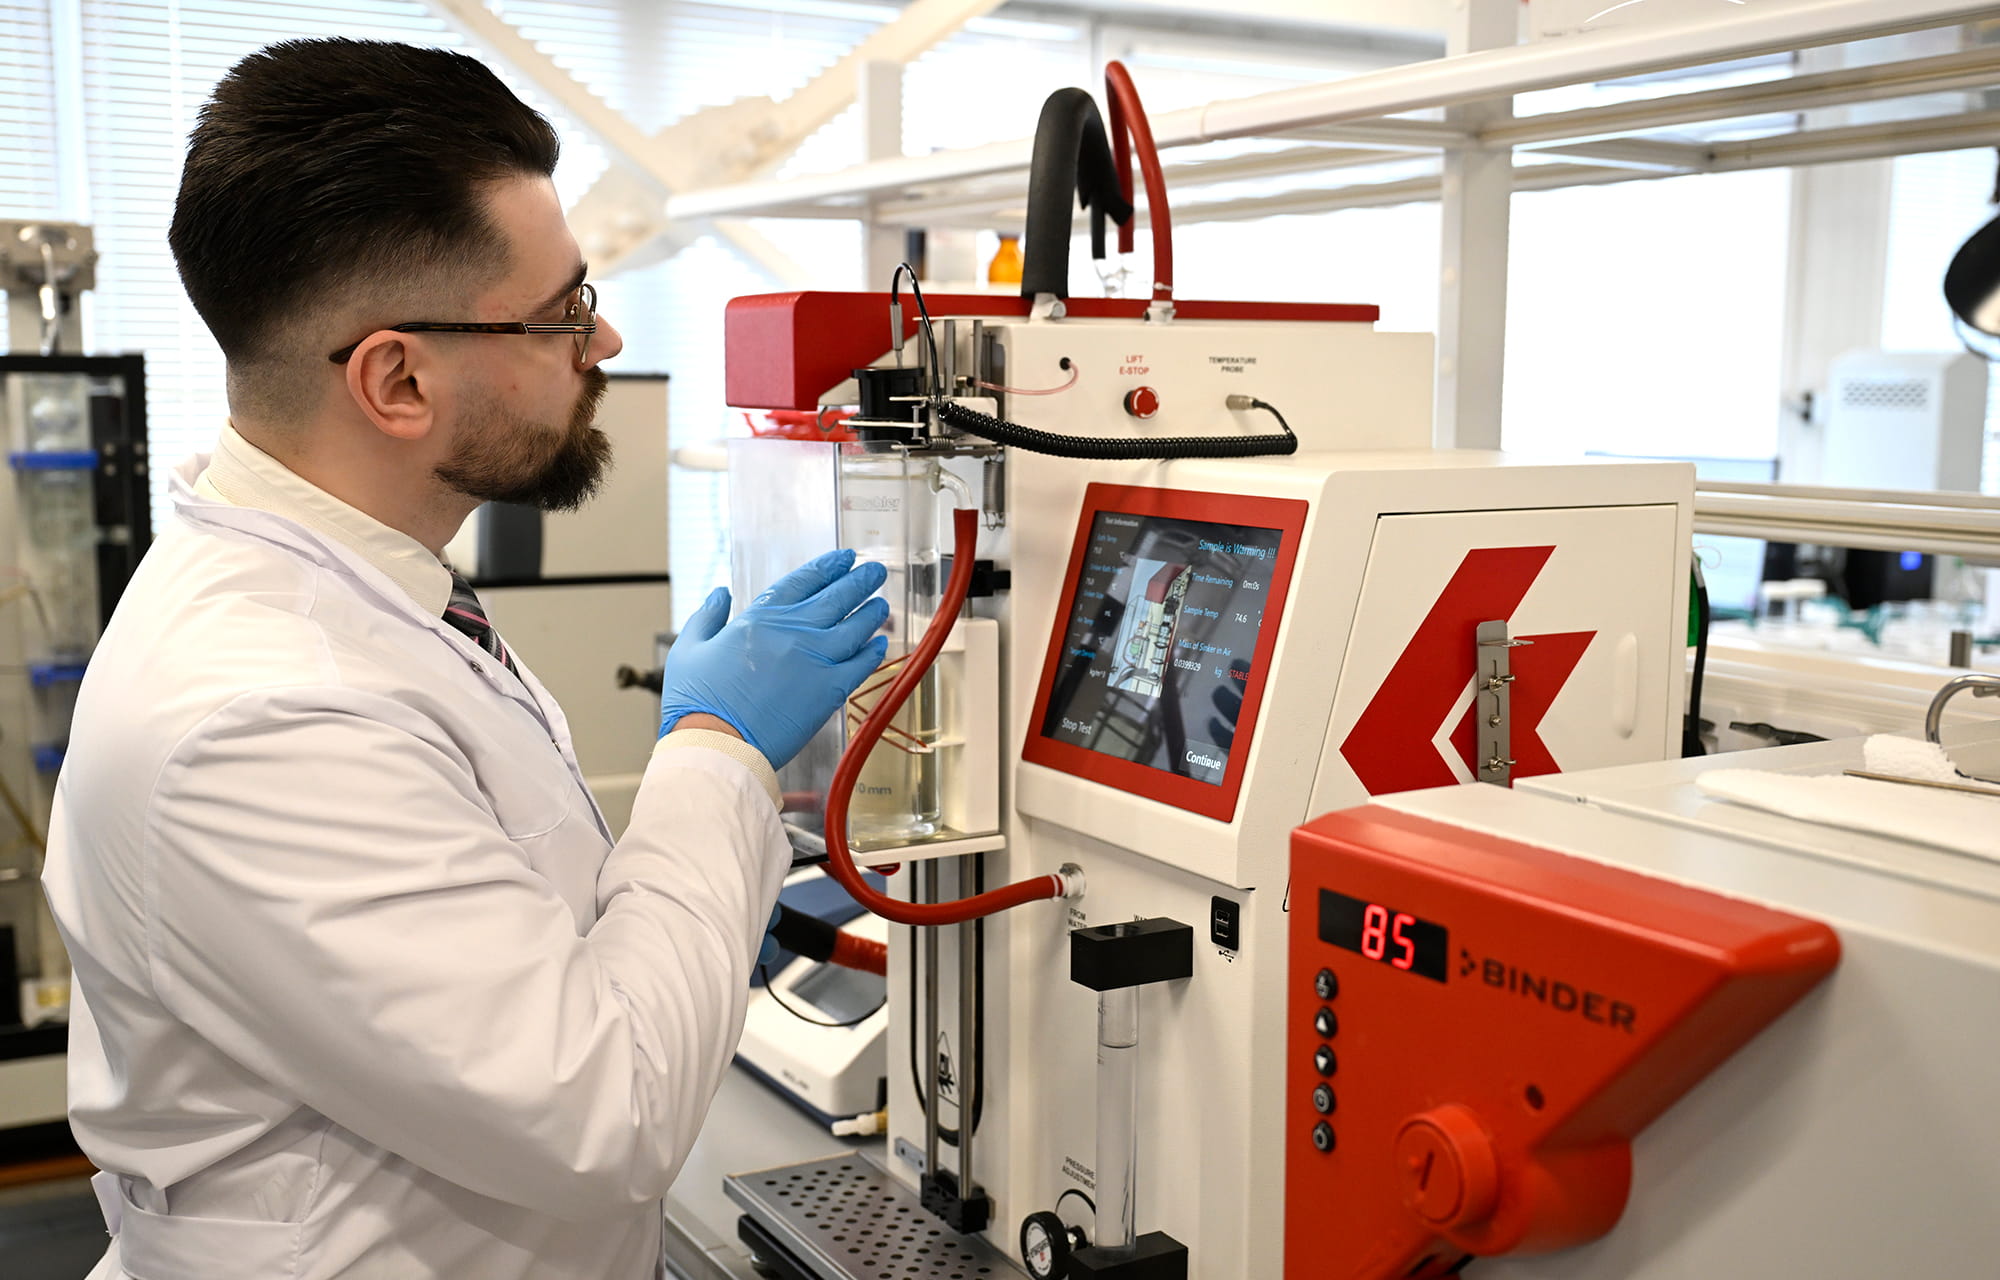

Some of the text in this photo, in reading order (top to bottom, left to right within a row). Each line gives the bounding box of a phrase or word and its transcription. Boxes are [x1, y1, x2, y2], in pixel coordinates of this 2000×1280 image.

[1126, 355, 1143, 363] LIFT
[1119, 366, 1150, 375] E-STOP
[1198, 539, 1224, 554] Sample
[1225, 542, 1232, 552] is
[1233, 544, 1266, 560] Warming
[1192, 572, 1234, 589] Time Remaining
[1184, 604, 1219, 620] Sample Temp
[1178, 639, 1192, 649] Mass
[1192, 642, 1200, 650] of
[1199, 643, 1217, 654] Sinker
[1222, 647, 1232, 656] Air
[1062, 717, 1092, 735] Stop Test
[1186, 750, 1221, 770] Continue
[1069, 907, 1086, 920] FROM
[1361, 903, 1416, 970] 85
[1482, 957, 1637, 1033] BINDER
[1065, 1155, 1095, 1180] PRESSURE
[1062, 1164, 1096, 1190] ADJUSTMEN
